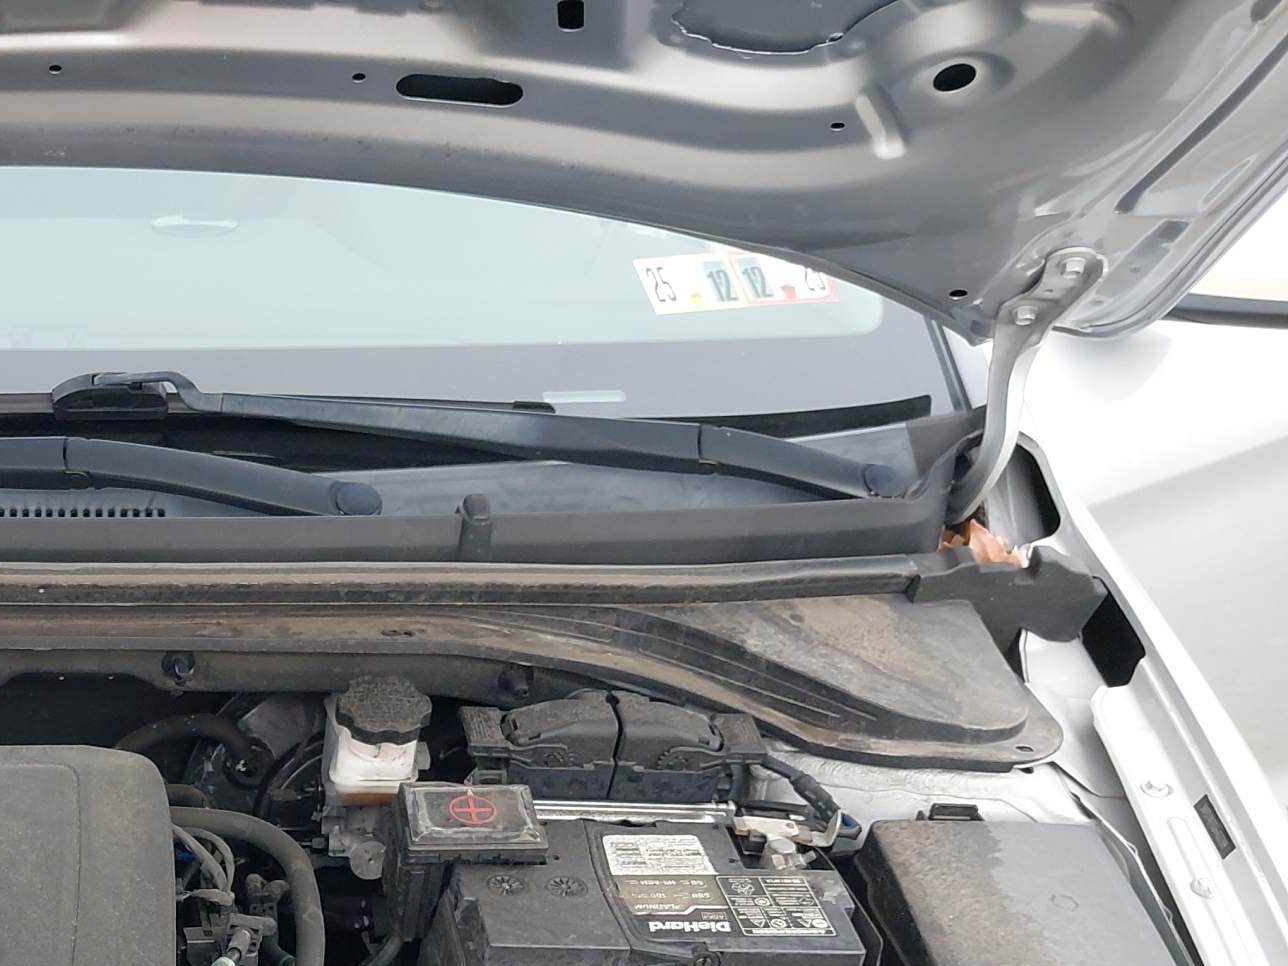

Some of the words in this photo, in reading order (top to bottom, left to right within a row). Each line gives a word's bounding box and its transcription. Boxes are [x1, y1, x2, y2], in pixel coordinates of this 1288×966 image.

[644, 267, 677, 303] 25
[707, 269, 738, 302] 12
[742, 265, 775, 298] 12
[647, 921, 732, 933] DieHard
